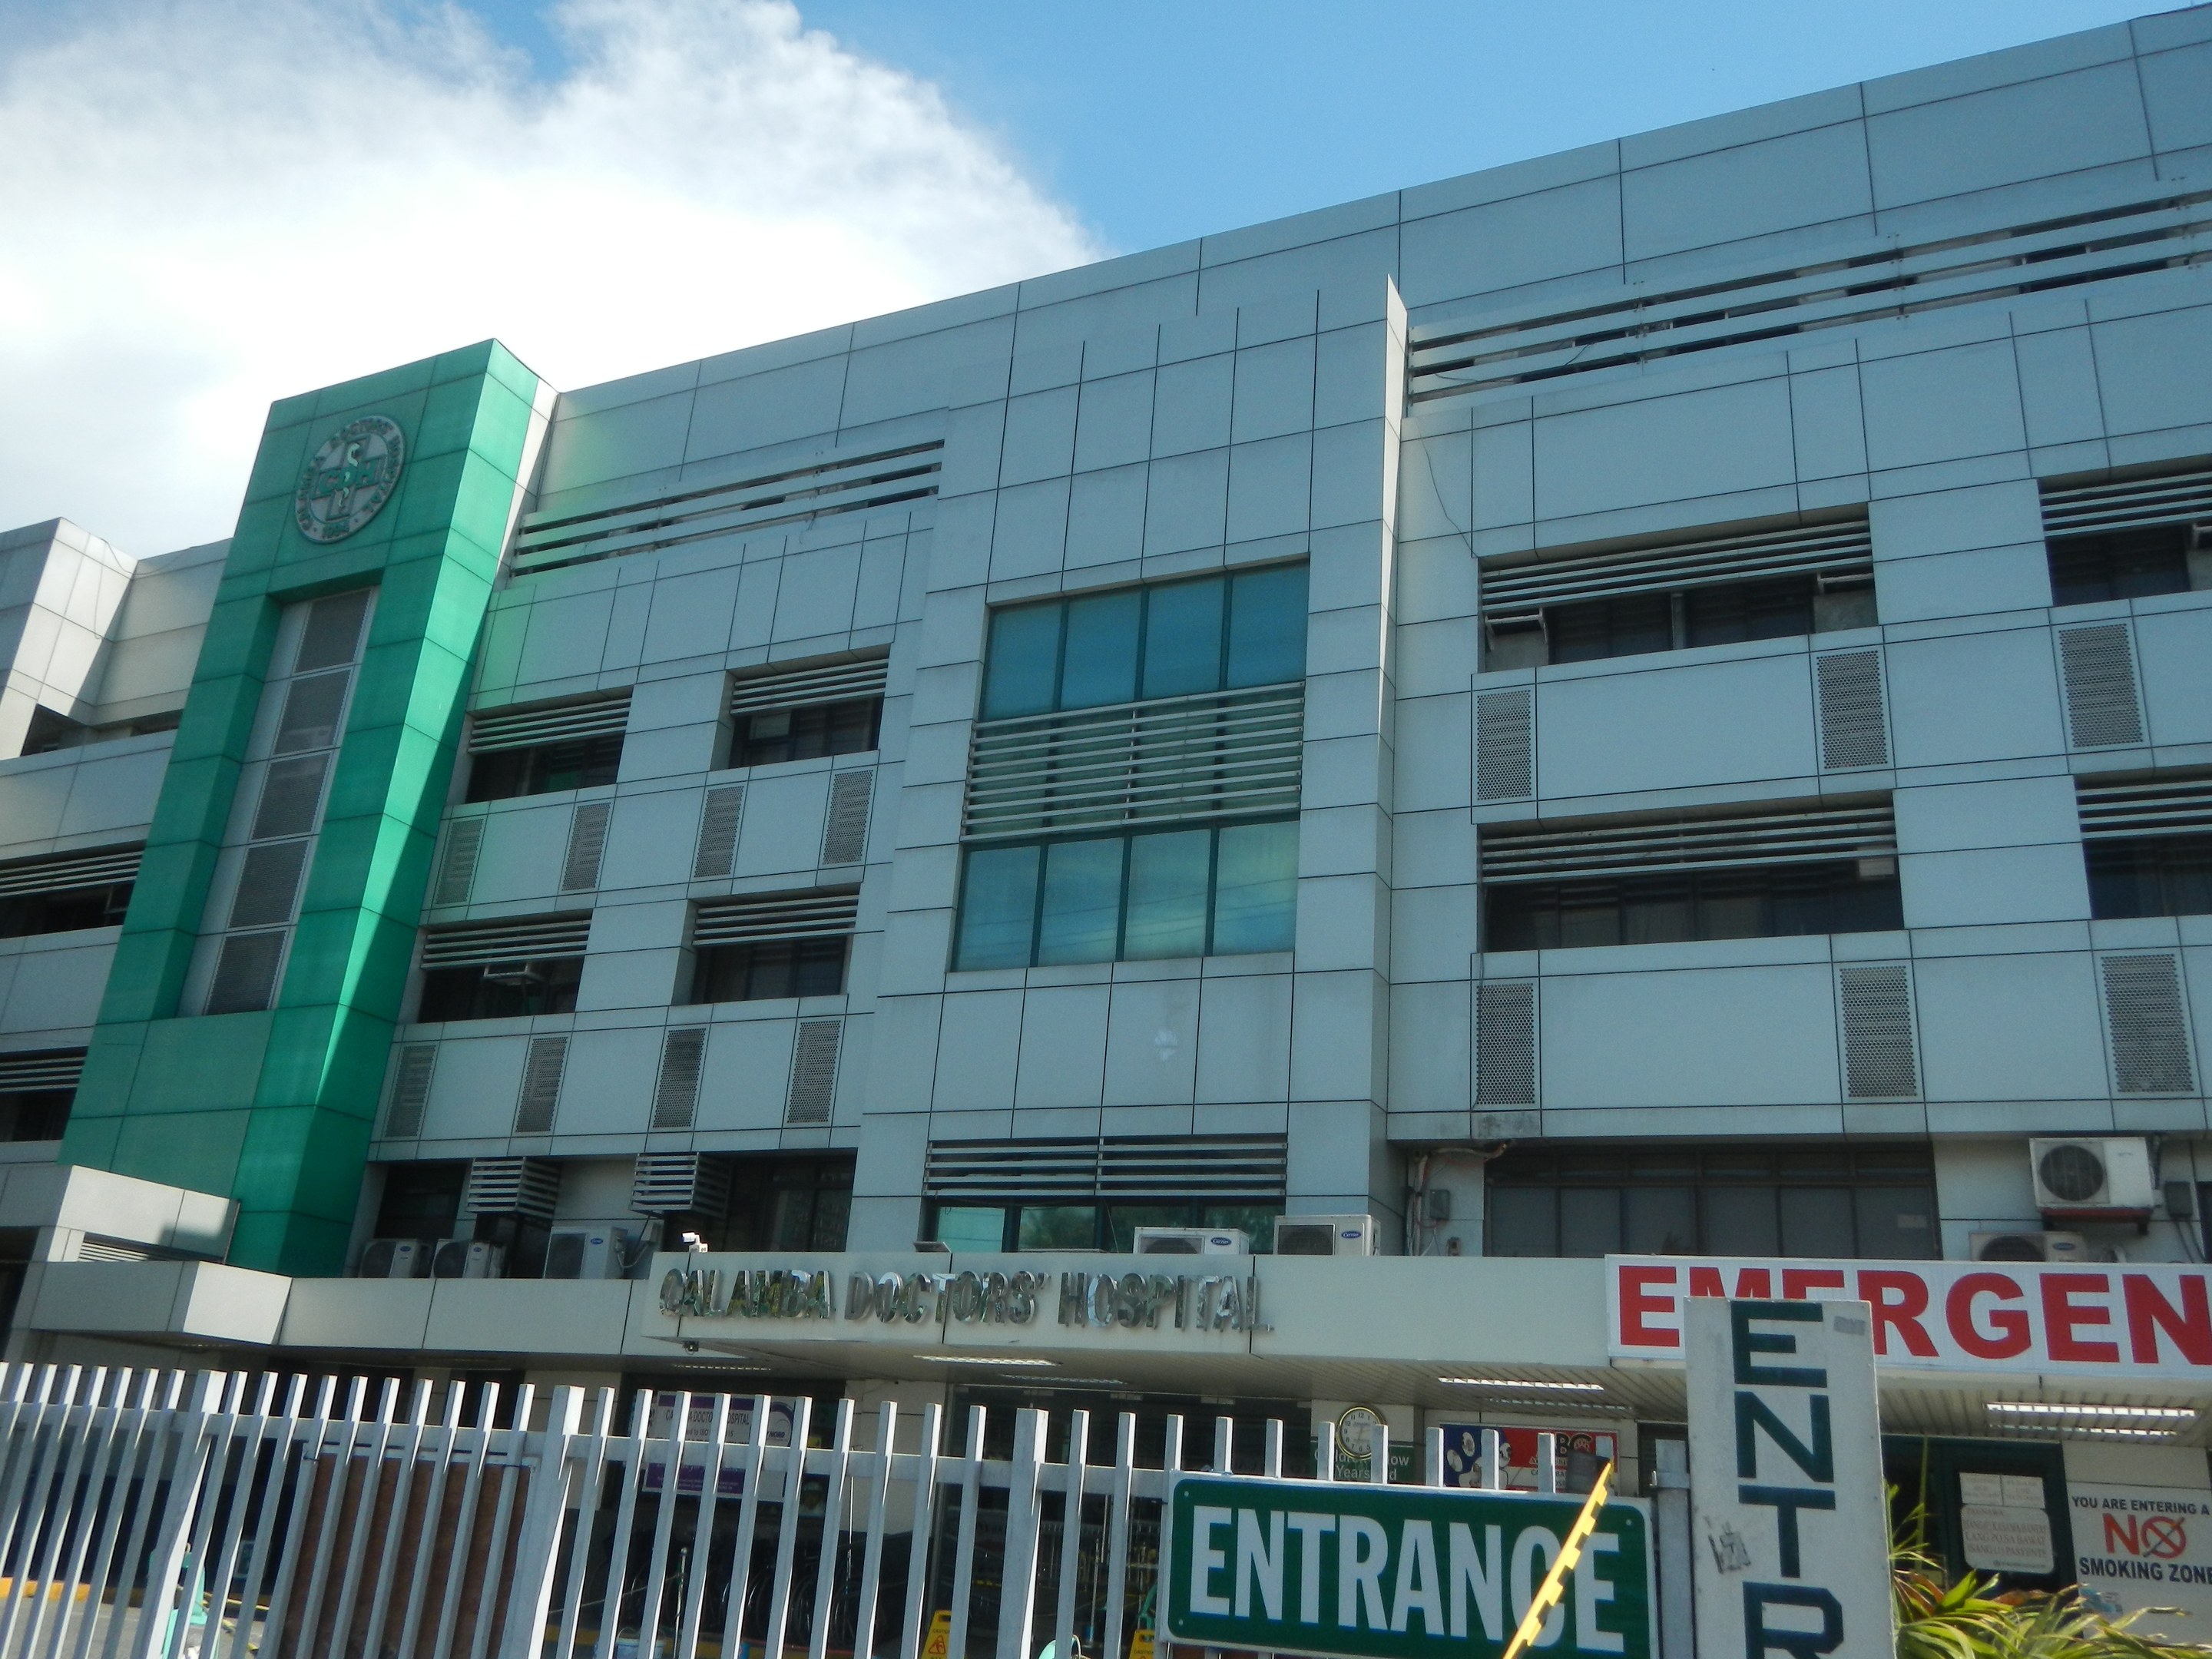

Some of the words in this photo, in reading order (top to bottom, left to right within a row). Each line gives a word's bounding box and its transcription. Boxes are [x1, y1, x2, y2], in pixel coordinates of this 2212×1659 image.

[659, 1269, 836, 1320] CALAMBA
[845, 1270, 1050, 1325] DOCTORS'
[1058, 1272, 1274, 1333] HOSPITAL
[727, 1412, 750, 1425] OSPITAL
[1335, 1465, 1370, 1479] Years
[2072, 1496, 2098, 1508] YOU
[2102, 1498, 2128, 1510] ARE
[2131, 1499, 2197, 1515] ENTERING
[2200, 1505, 2210, 1515] A
[1189, 1505, 1625, 1654] ENTRANCE
[2079, 1557, 2164, 1581] SMOKING
